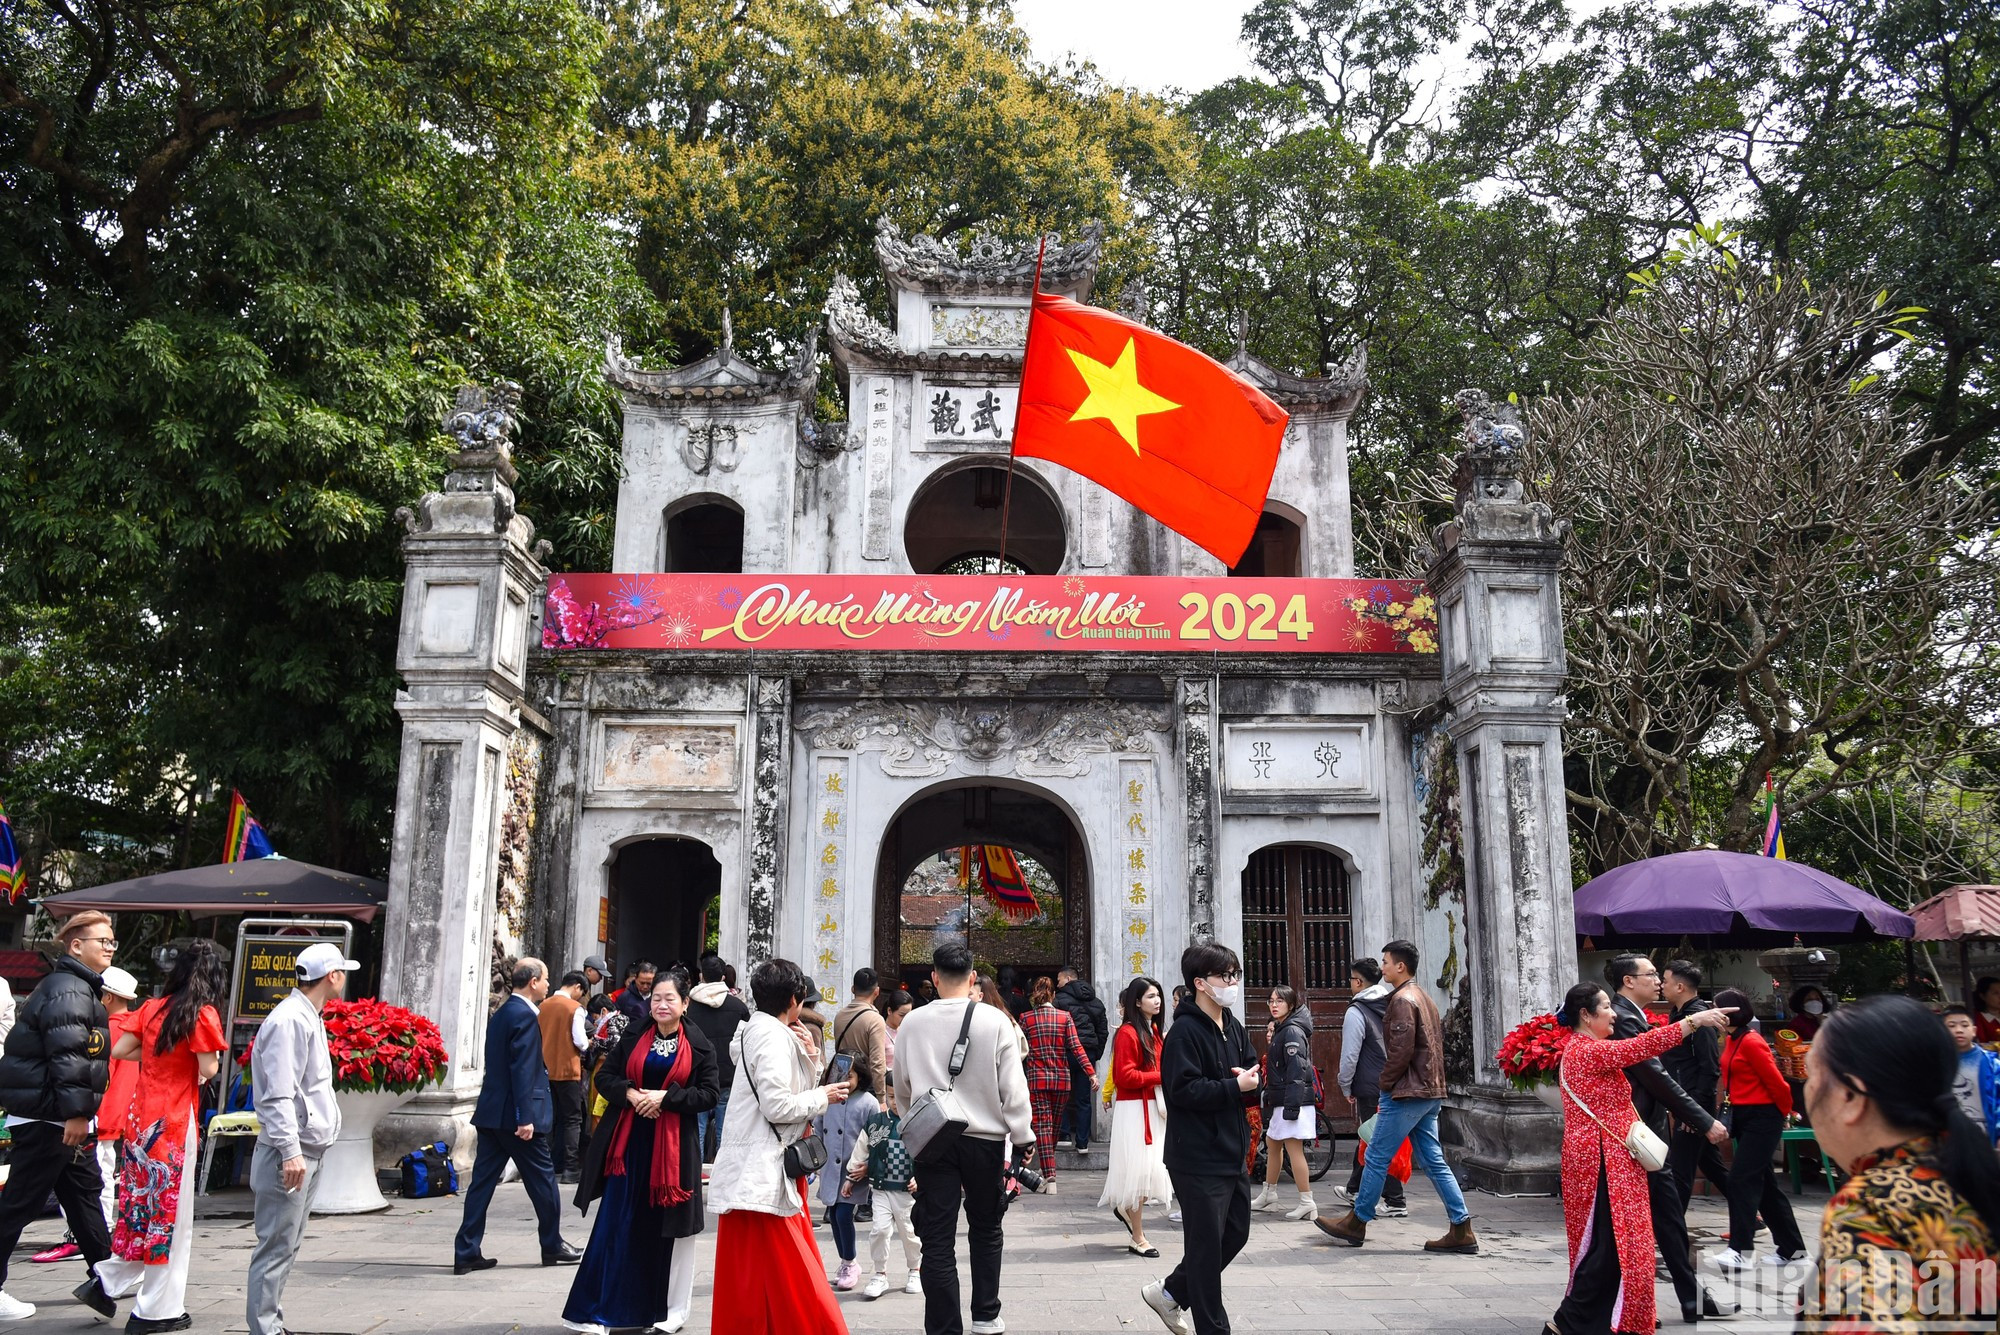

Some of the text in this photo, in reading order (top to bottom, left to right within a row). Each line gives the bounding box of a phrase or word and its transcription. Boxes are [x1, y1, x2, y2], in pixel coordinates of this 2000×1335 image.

[700, 583, 1315, 642] Chúc Mừng Năm Mới 2024
[1115, 627, 1143, 640] Giáp
[251, 948, 271, 970] ĐỀN
[255, 974, 271, 987] TRẤN
[257, 1002, 270, 1010] TÍCH
